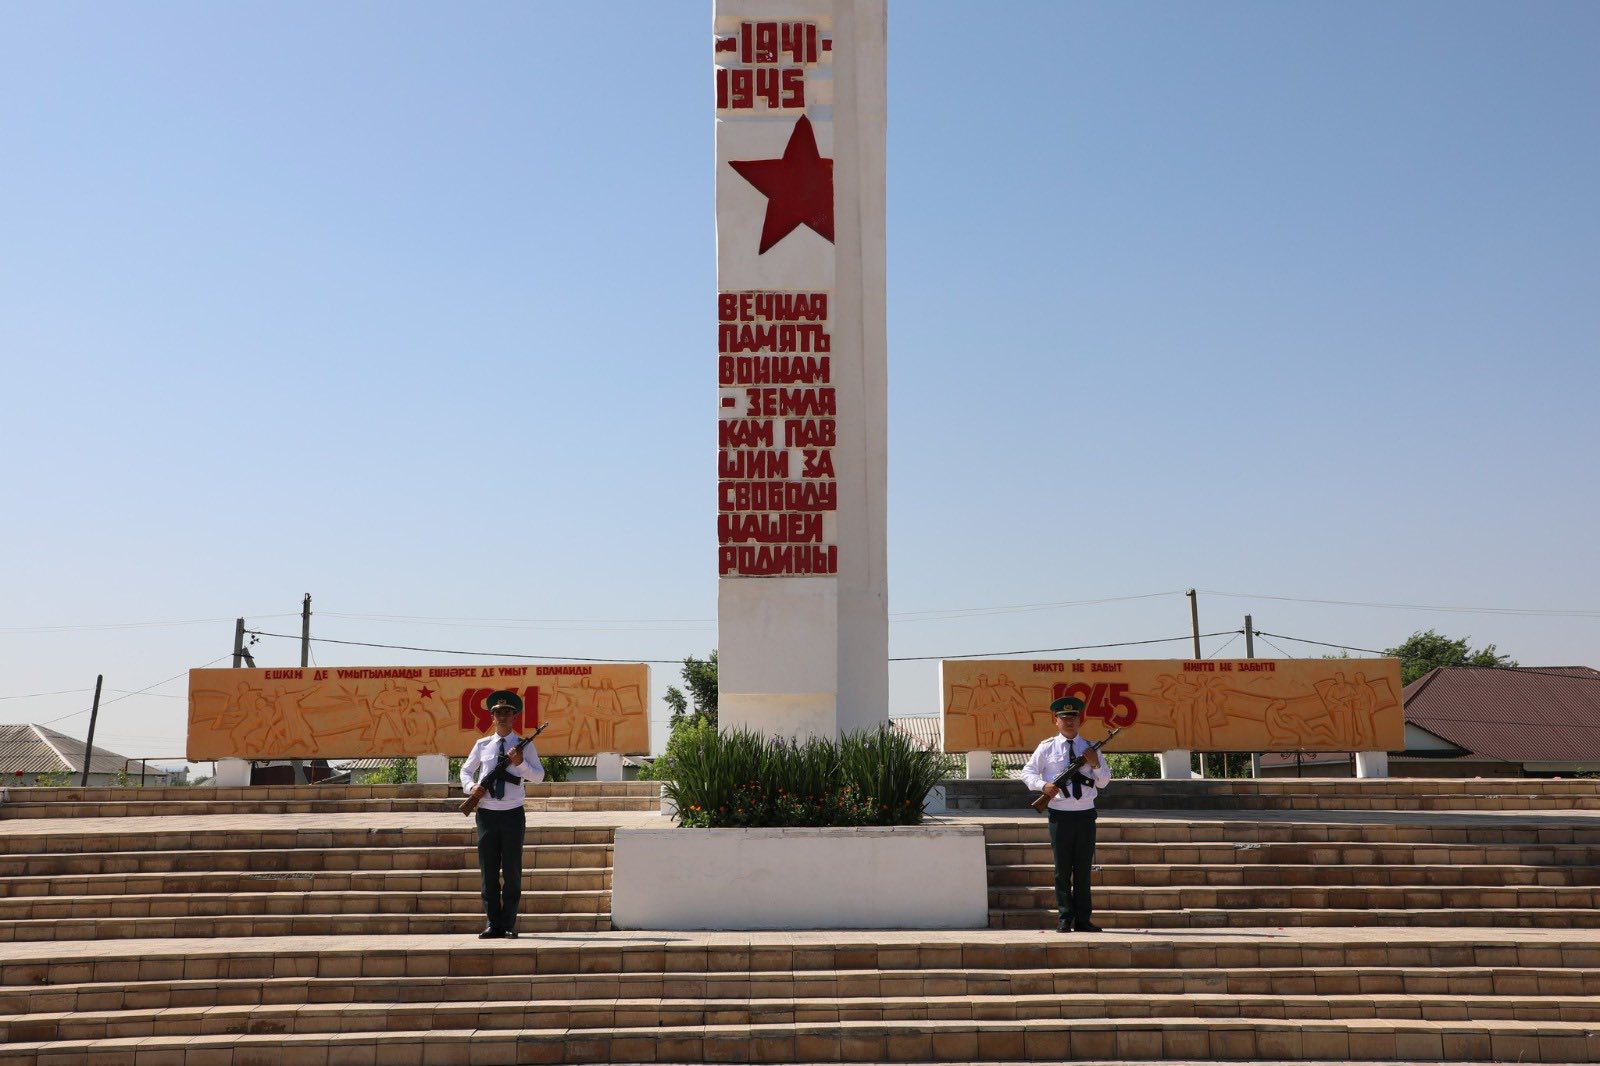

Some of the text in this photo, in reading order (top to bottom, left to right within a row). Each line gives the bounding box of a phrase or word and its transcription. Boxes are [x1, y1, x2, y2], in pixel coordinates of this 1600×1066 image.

[718, 69, 804, 109] 1945
[719, 294, 827, 321] ВЕЧНАЯ
[719, 324, 830, 353] ПАМЯТЬ
[719, 357, 829, 385] ВОИНАМ
[718, 420, 836, 448] КАМ ПАВ
[719, 449, 835, 479] ШИМ ЗА
[719, 482, 836, 512] СВОБОДУ
[719, 546, 836, 573] РОДИНЫ
[313, 669, 329, 681] ДЕ
[480, 667, 495, 678] ДЕ
[1033, 662, 1124, 673] НИКТО НЕ ЗАБЫТ
[1218, 662, 1233, 673] НЕ
[1238, 662, 1276, 672] ЗАБЫТО
